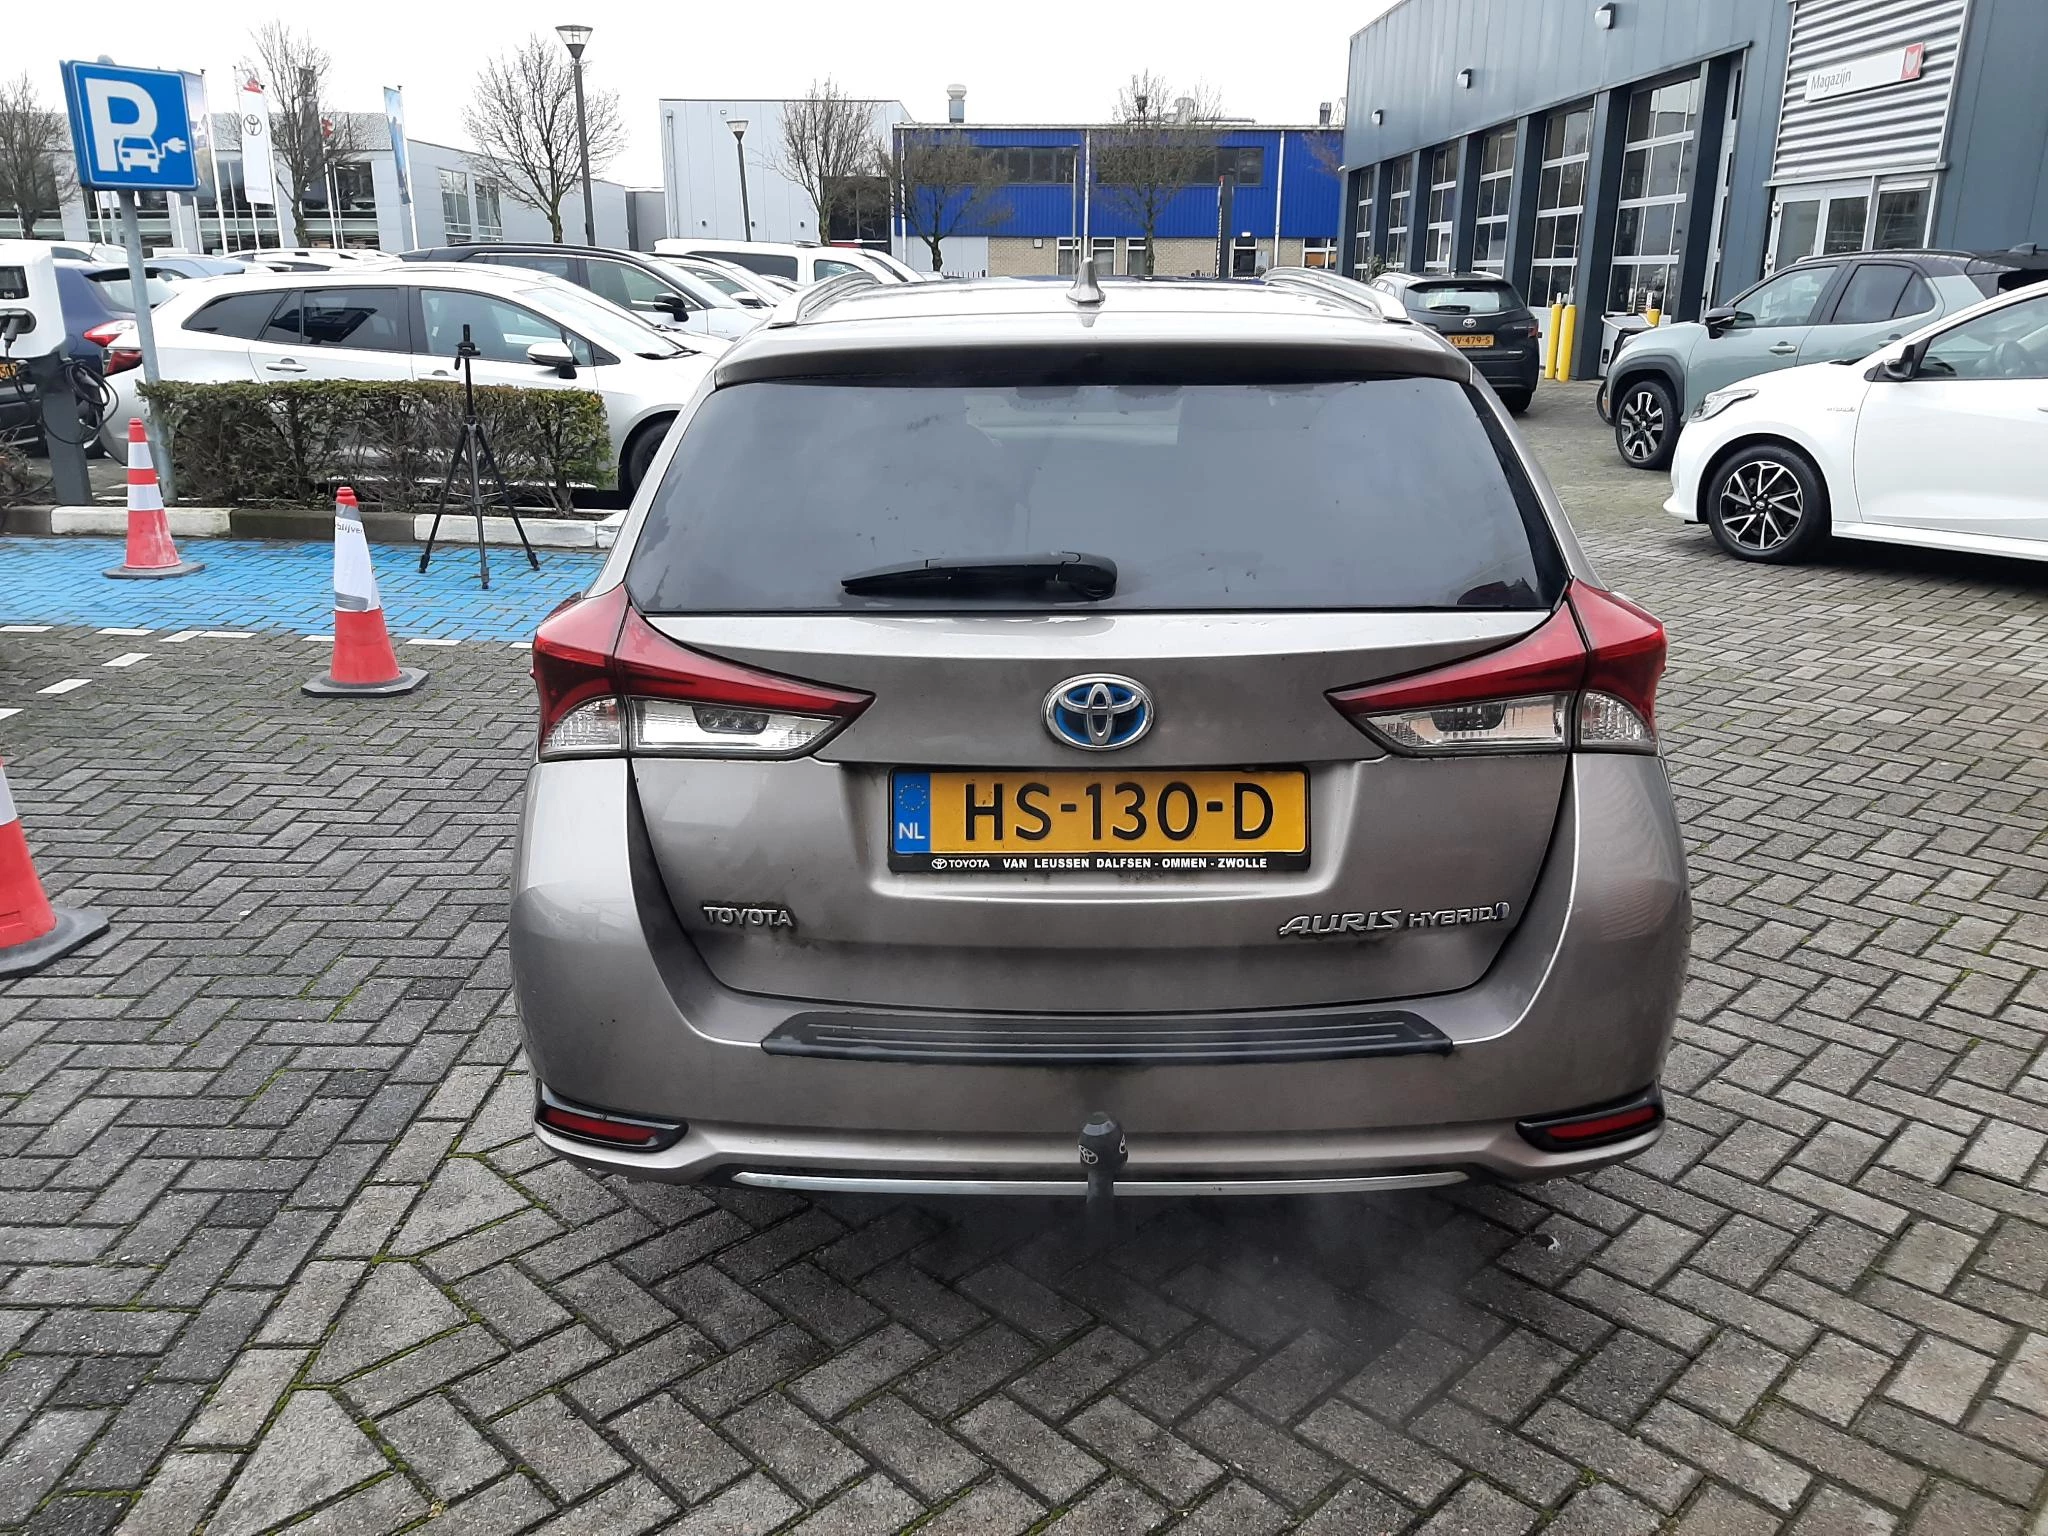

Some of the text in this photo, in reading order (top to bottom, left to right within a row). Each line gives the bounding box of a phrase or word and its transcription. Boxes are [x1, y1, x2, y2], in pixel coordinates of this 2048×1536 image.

[1811, 68, 1852, 93] Magazijn
[85, 77, 158, 172] P
[1450, 335, 1491, 345] XV-479-S
[965, 782, 1274, 841] HS-130-D
[899, 822, 925, 840] NL
[949, 859, 990, 868] TOYOTA
[1003, 858, 1027, 868] VAN
[1034, 858, 1090, 868] LEUSSEN
[1096, 858, 1151, 868] DALFSEN
[1162, 858, 1206, 868] OMMEN
[1218, 858, 1267, 868] ZWOLLE
[703, 906, 793, 926] TOYOTA
[1279, 906, 1494, 935] AURIS HYBRID
